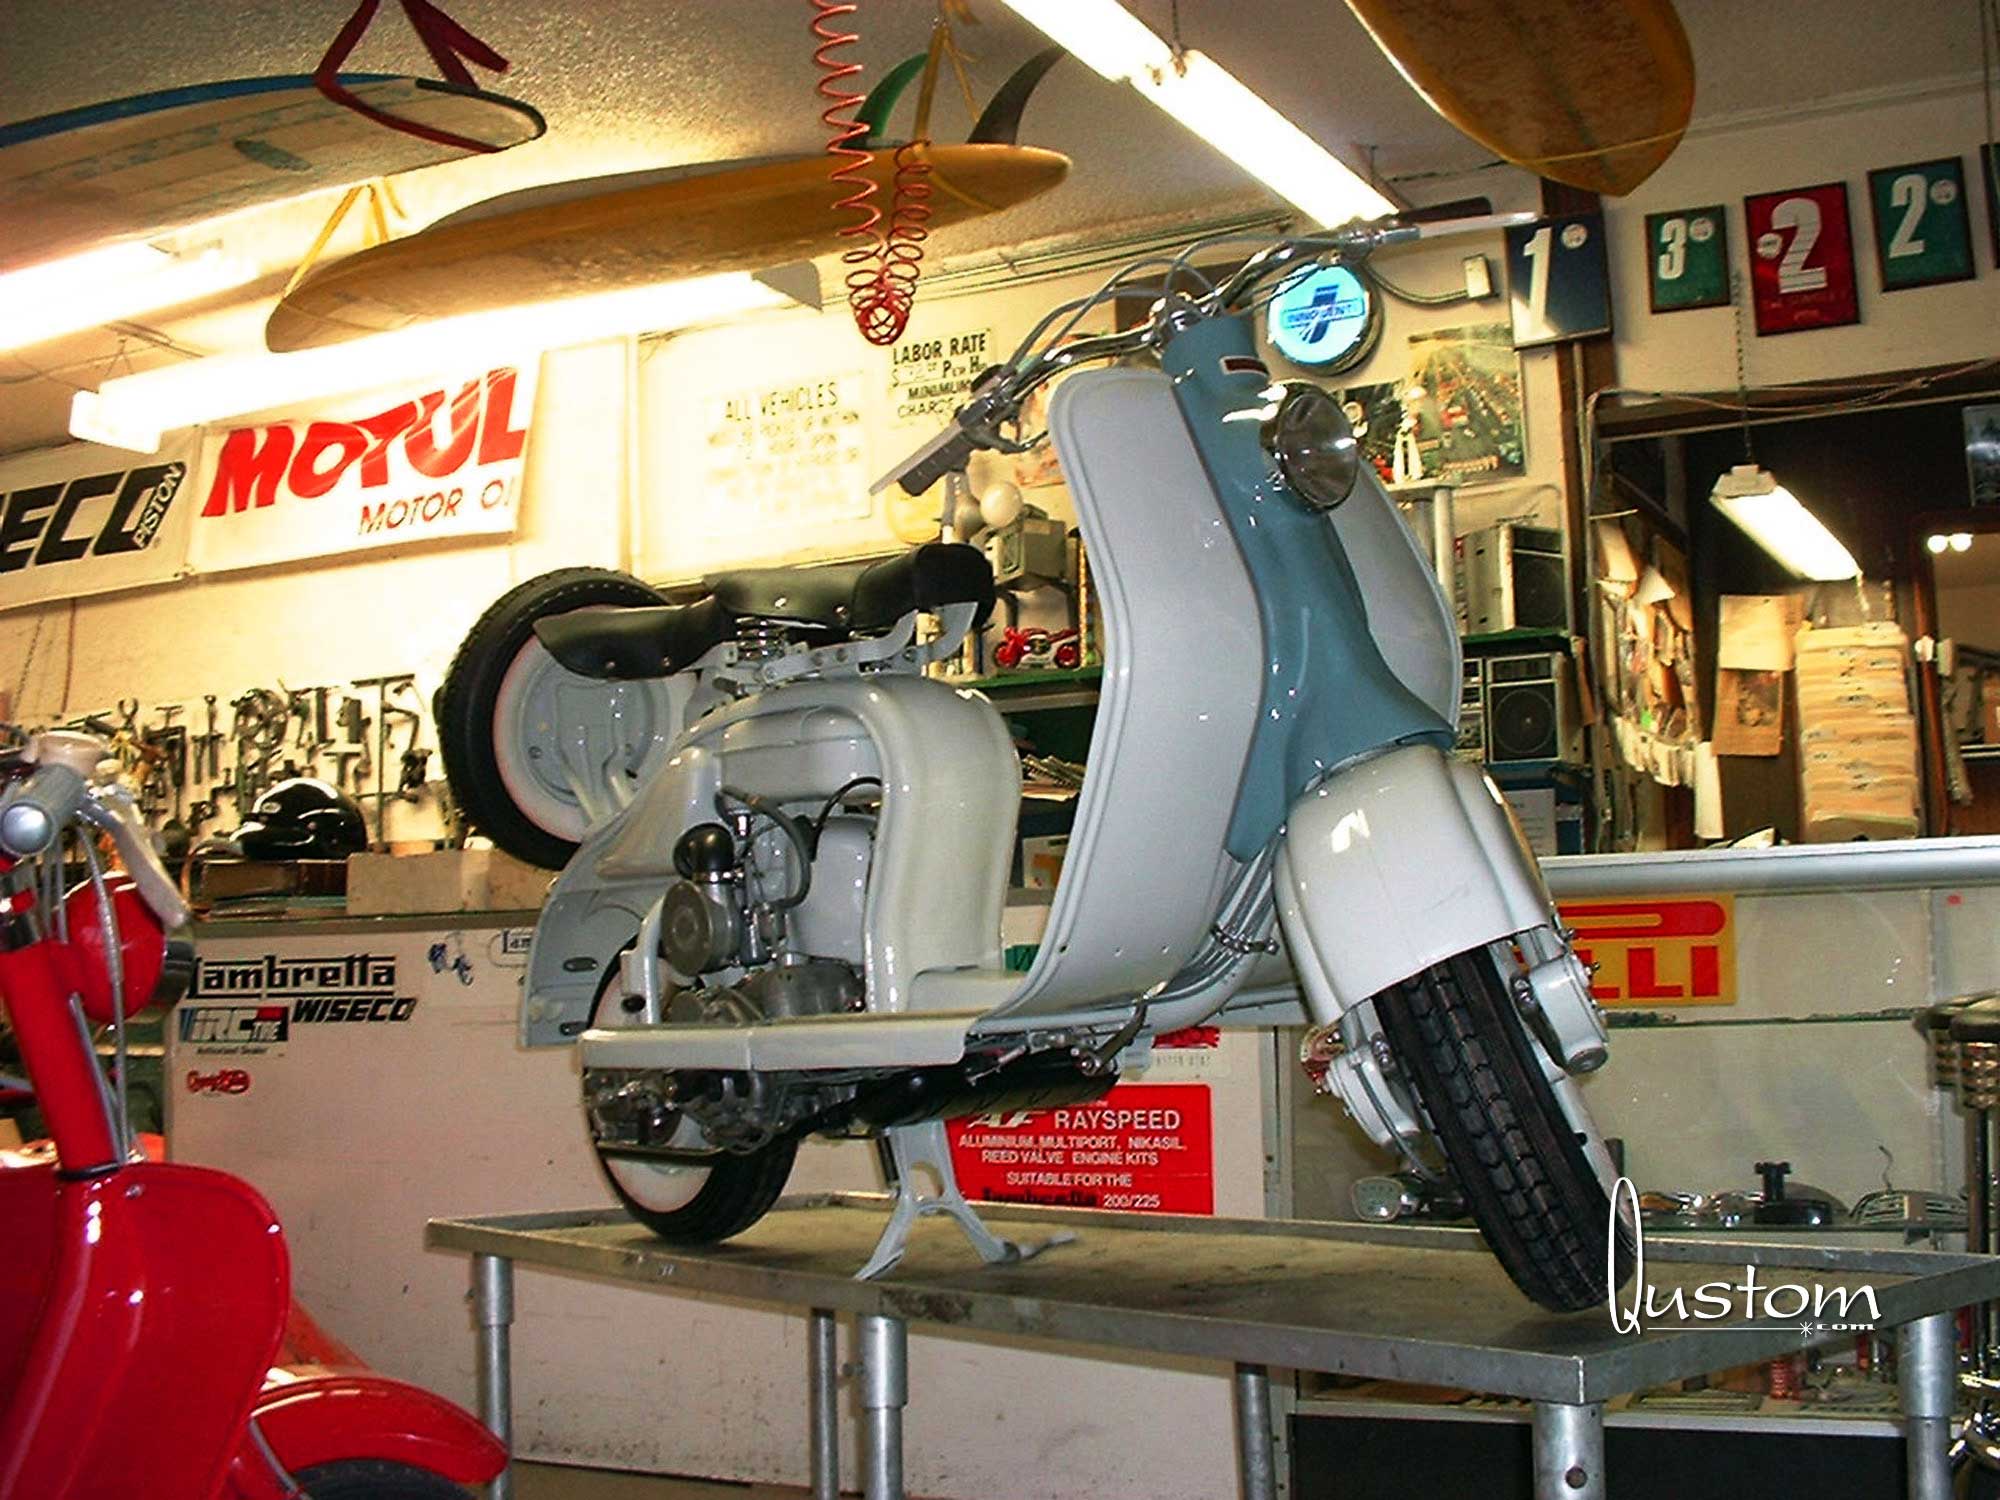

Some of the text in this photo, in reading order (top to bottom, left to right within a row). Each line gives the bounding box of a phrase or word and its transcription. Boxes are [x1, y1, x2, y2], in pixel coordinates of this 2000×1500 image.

[1889, 173, 1927, 259] 2
[1659, 217, 1688, 280] 3
[1771, 197, 1828, 294] 2
[1523, 227, 1552, 328] 1
[893, 332, 986, 366] LABOR RATE
[200, 366, 526, 519] MOTUL
[0, 461, 187, 575] ECO
[132, 463, 183, 550] PISTON
[357, 487, 463, 536] MOTOR
[186, 953, 396, 1000] Lambretta
[292, 998, 417, 1022] WISECO
[1054, 1109, 1181, 1130] RAYSPEED
[981, 1151, 1159, 1166] REED VALVE ENGINE KITS
[1006, 1170, 1132, 1188] SUITABLE FOR THE
